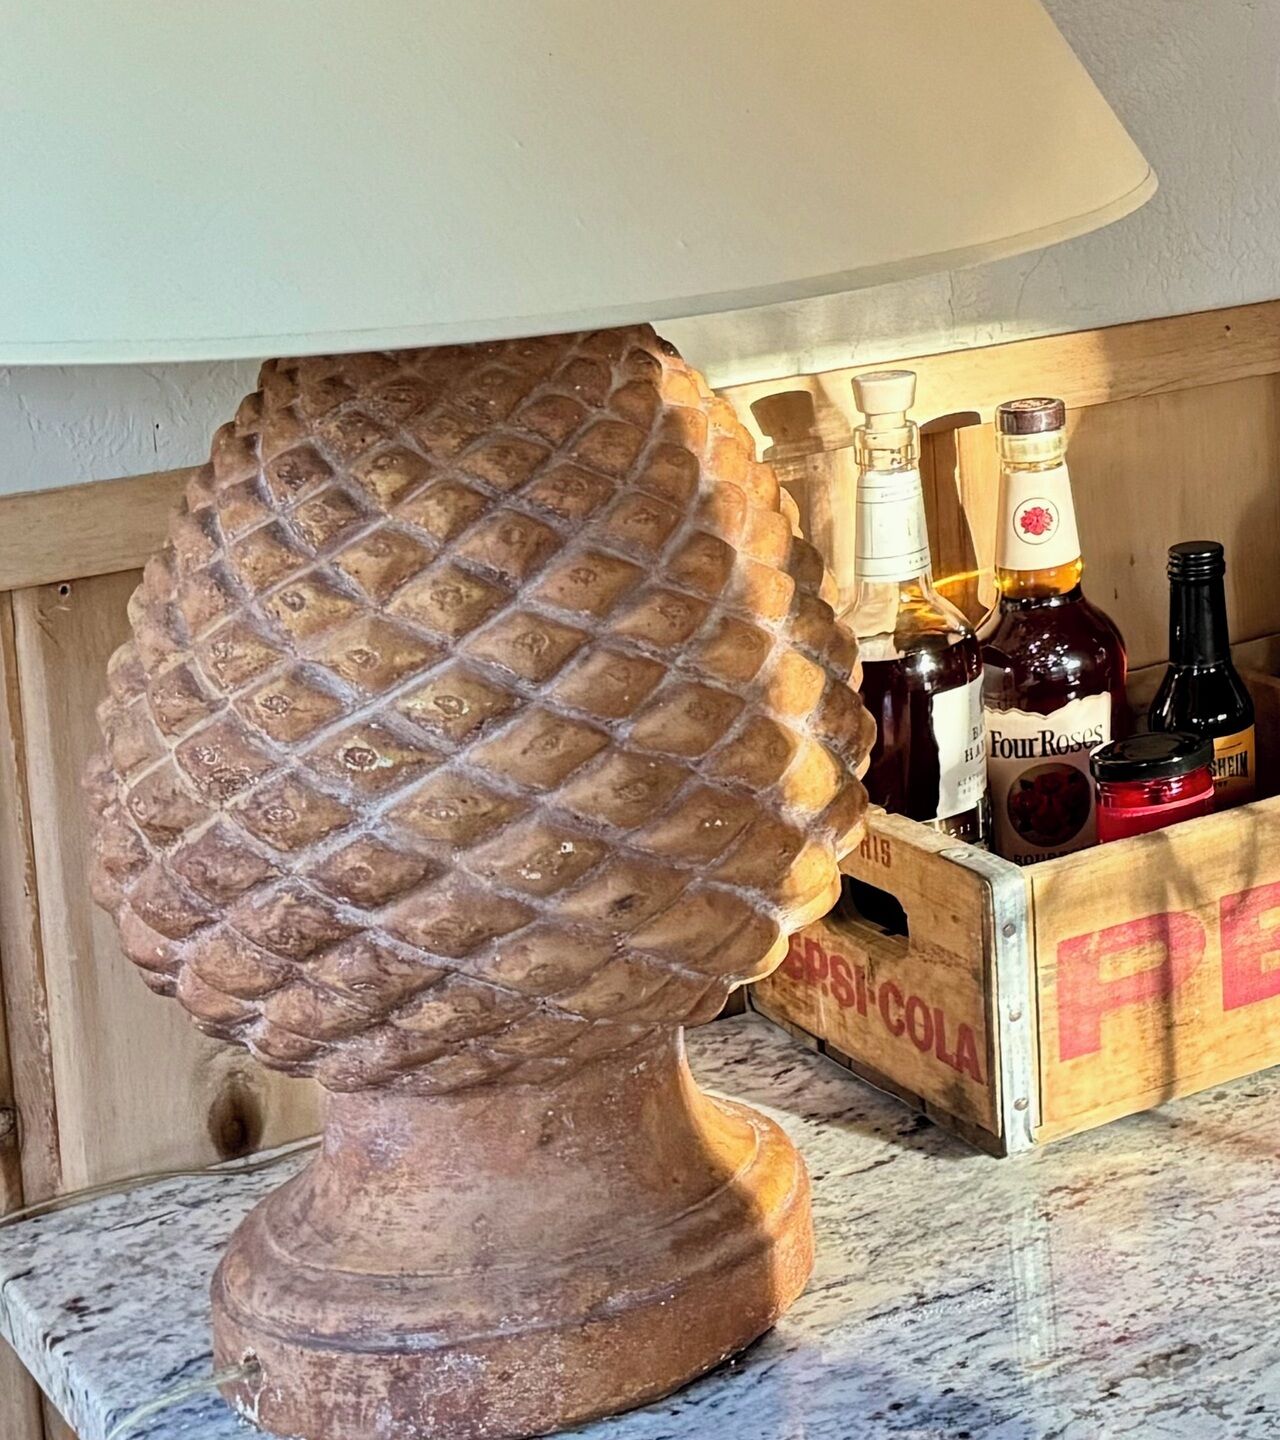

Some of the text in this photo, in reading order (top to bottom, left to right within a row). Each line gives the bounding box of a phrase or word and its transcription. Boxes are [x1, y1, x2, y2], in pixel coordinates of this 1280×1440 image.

[989, 730, 1038, 759] Four
[1037, 724, 1103, 758] Roses
[784, 934, 984, 1086] EPSI-COLA
